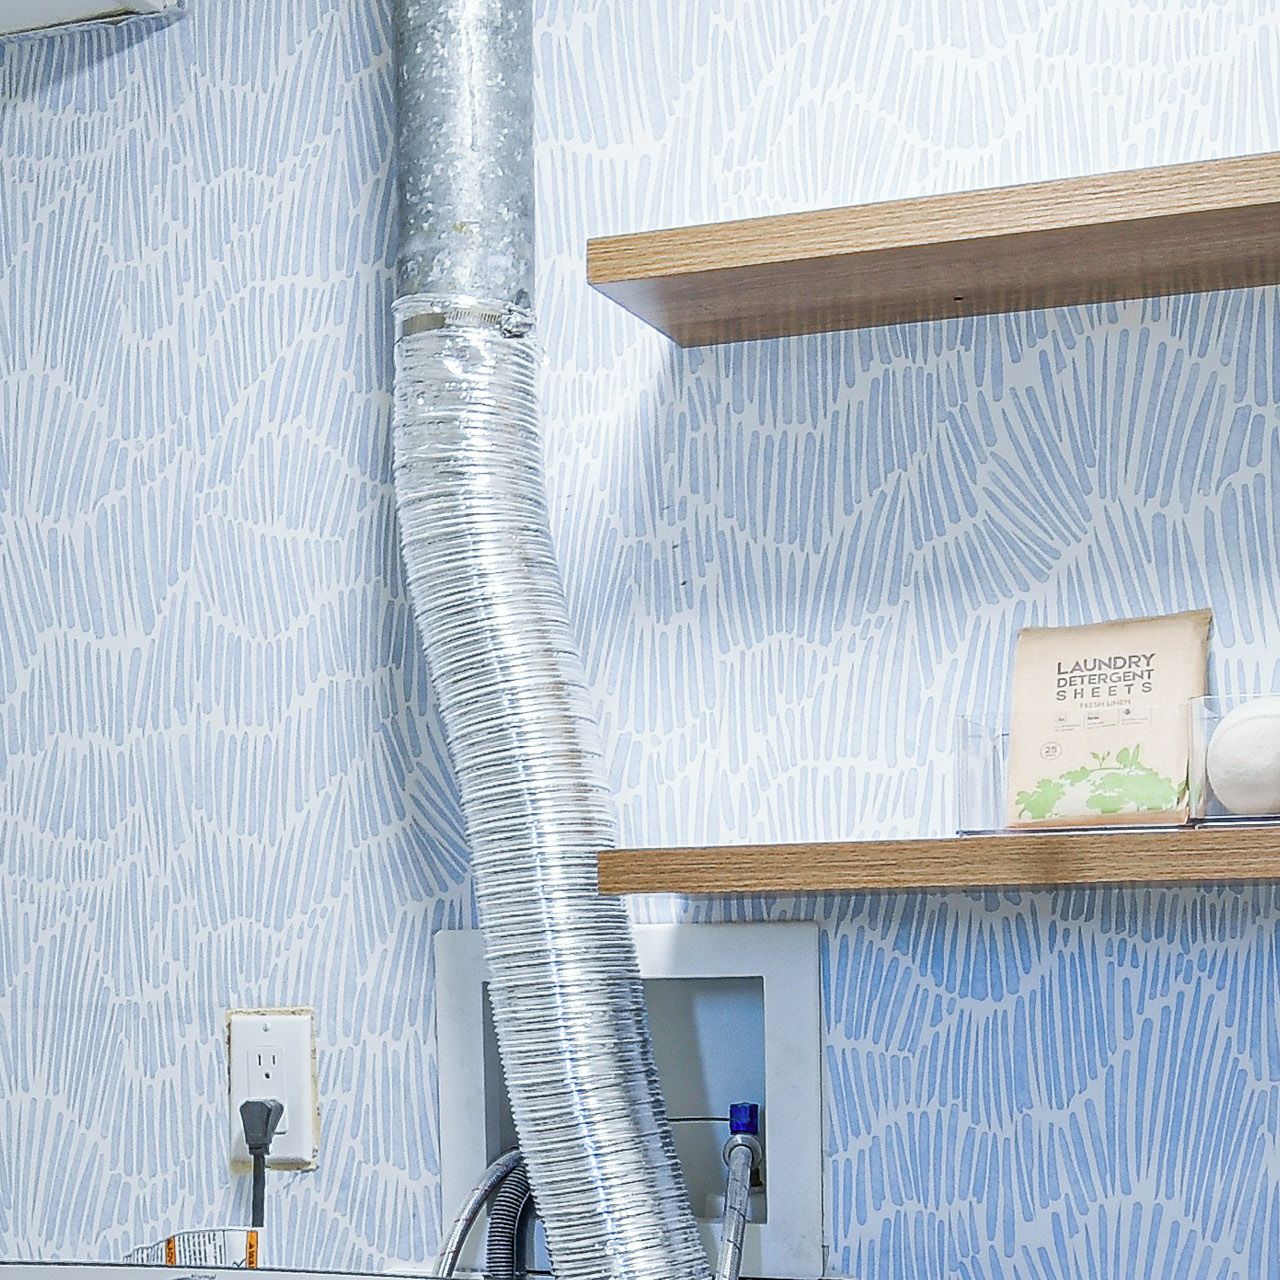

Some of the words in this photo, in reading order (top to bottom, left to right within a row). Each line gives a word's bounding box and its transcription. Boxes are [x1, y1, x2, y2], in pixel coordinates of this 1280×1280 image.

[1057, 653, 1156, 675] LAUNDRY
[1057, 669, 1154, 688] DETERGENT
[1056, 682, 1152, 701] SHEETS
[1045, 746, 1057, 754] 25
